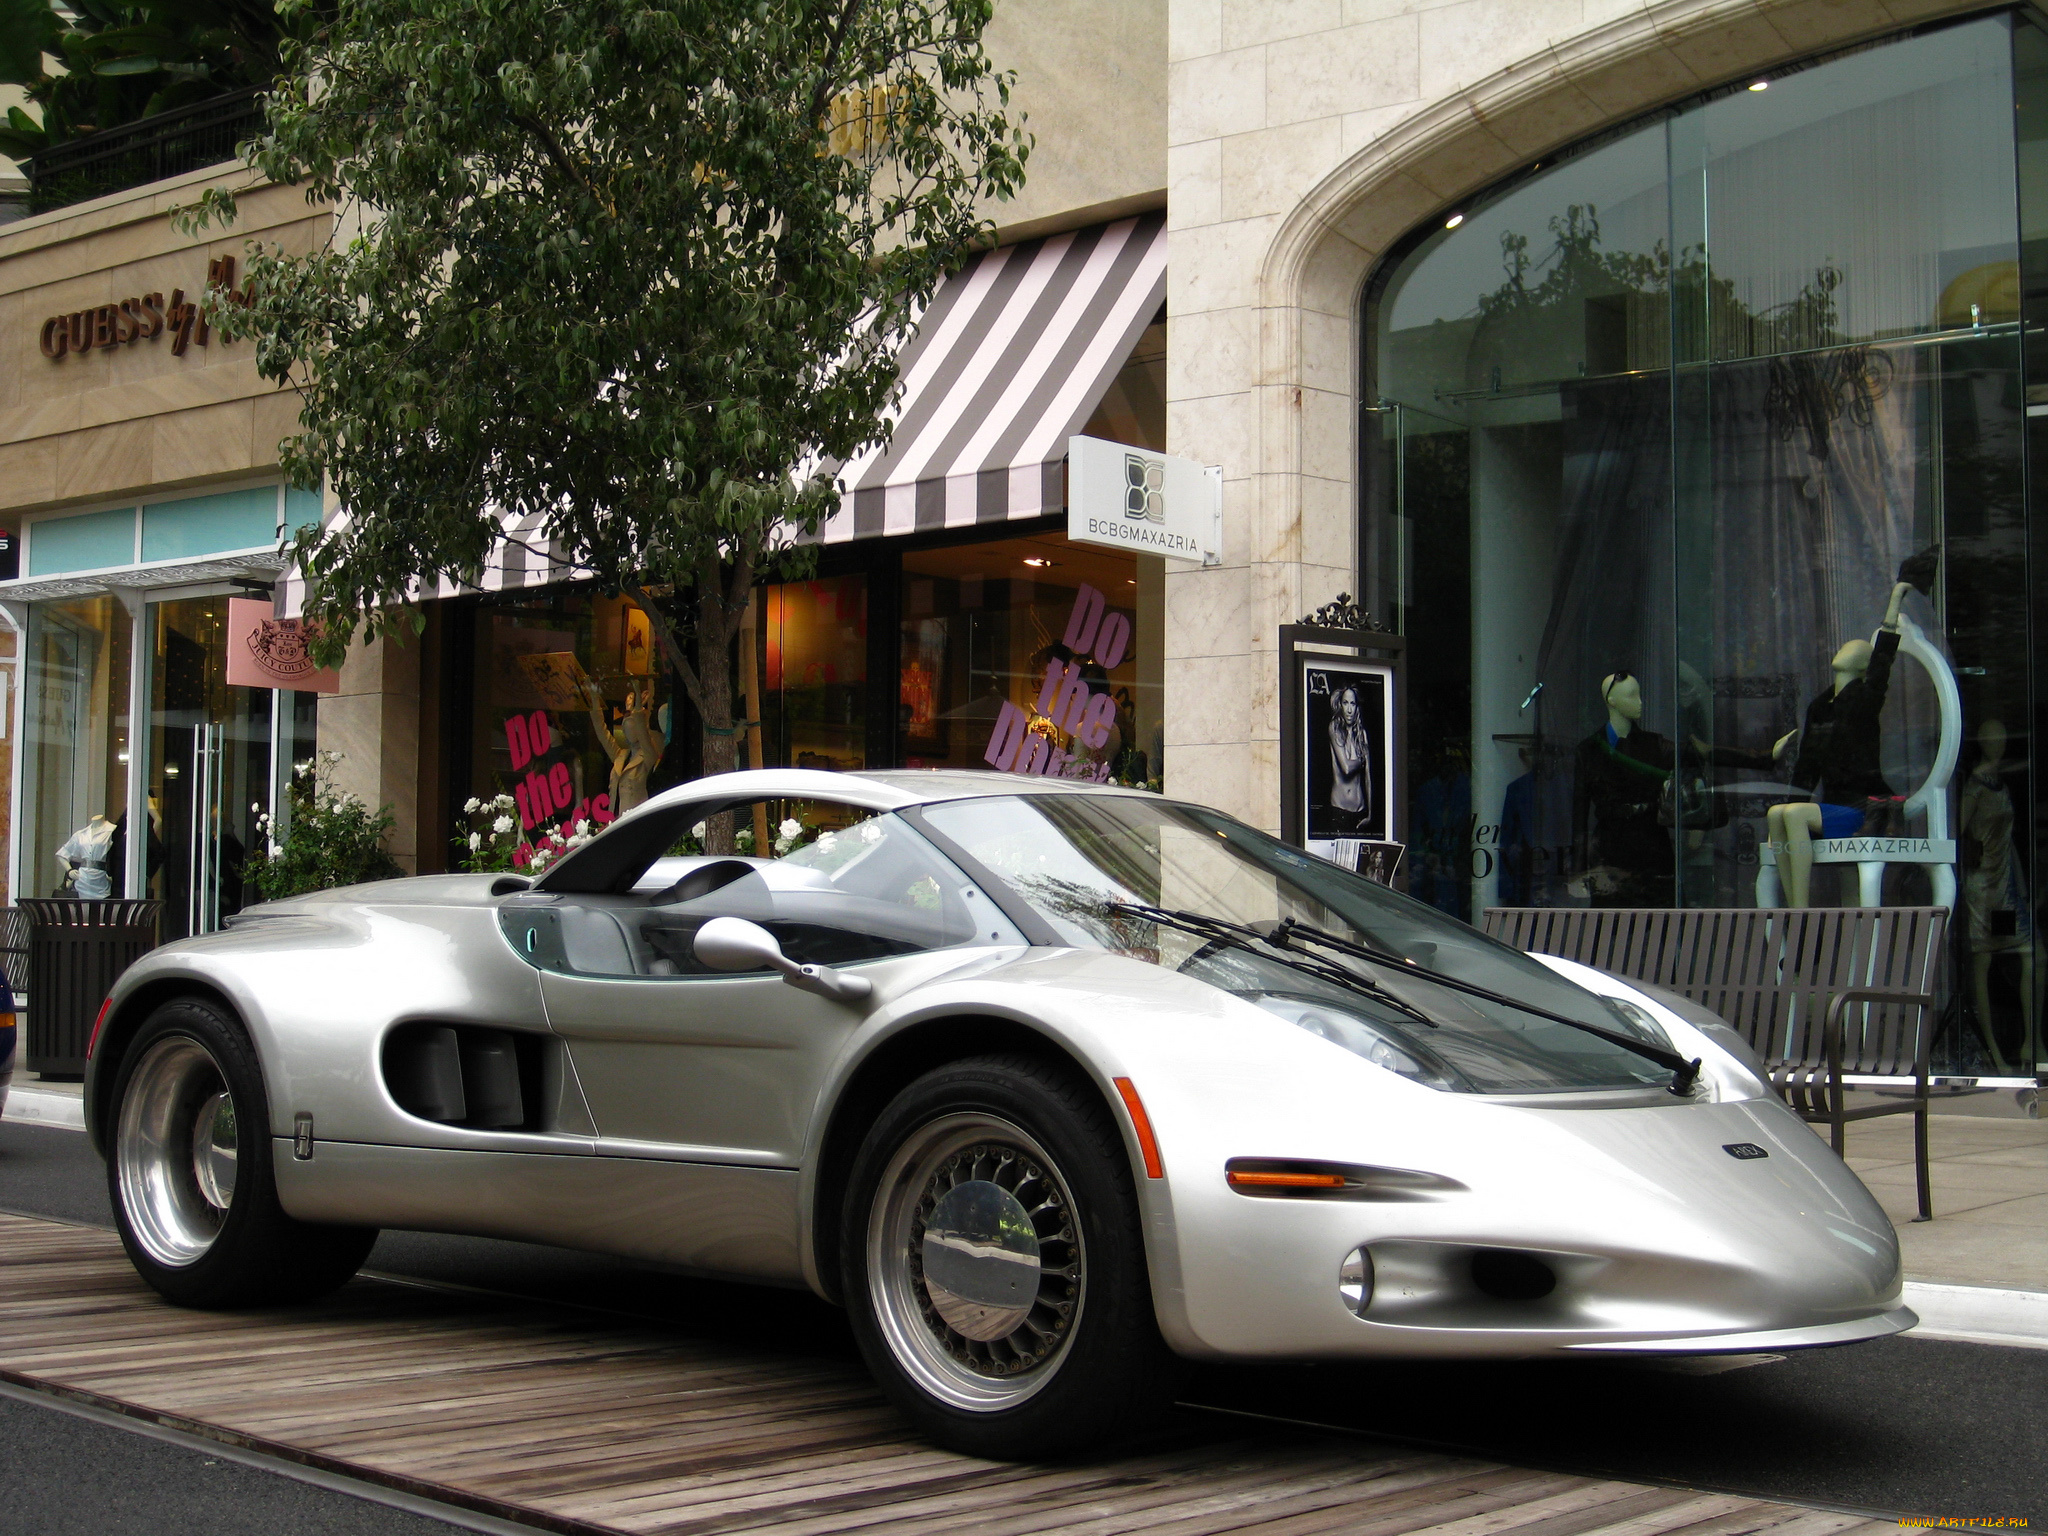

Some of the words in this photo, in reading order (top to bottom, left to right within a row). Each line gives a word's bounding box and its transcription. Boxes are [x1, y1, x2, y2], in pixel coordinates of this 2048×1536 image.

[40, 292, 163, 358] GUESS
[1088, 517, 1198, 552] BCBGMAXAZRIA
[251, 644, 277, 668] JUICY
[1037, 656, 1117, 749] the
[1309, 671, 1331, 695] LA
[515, 762, 573, 831] the
